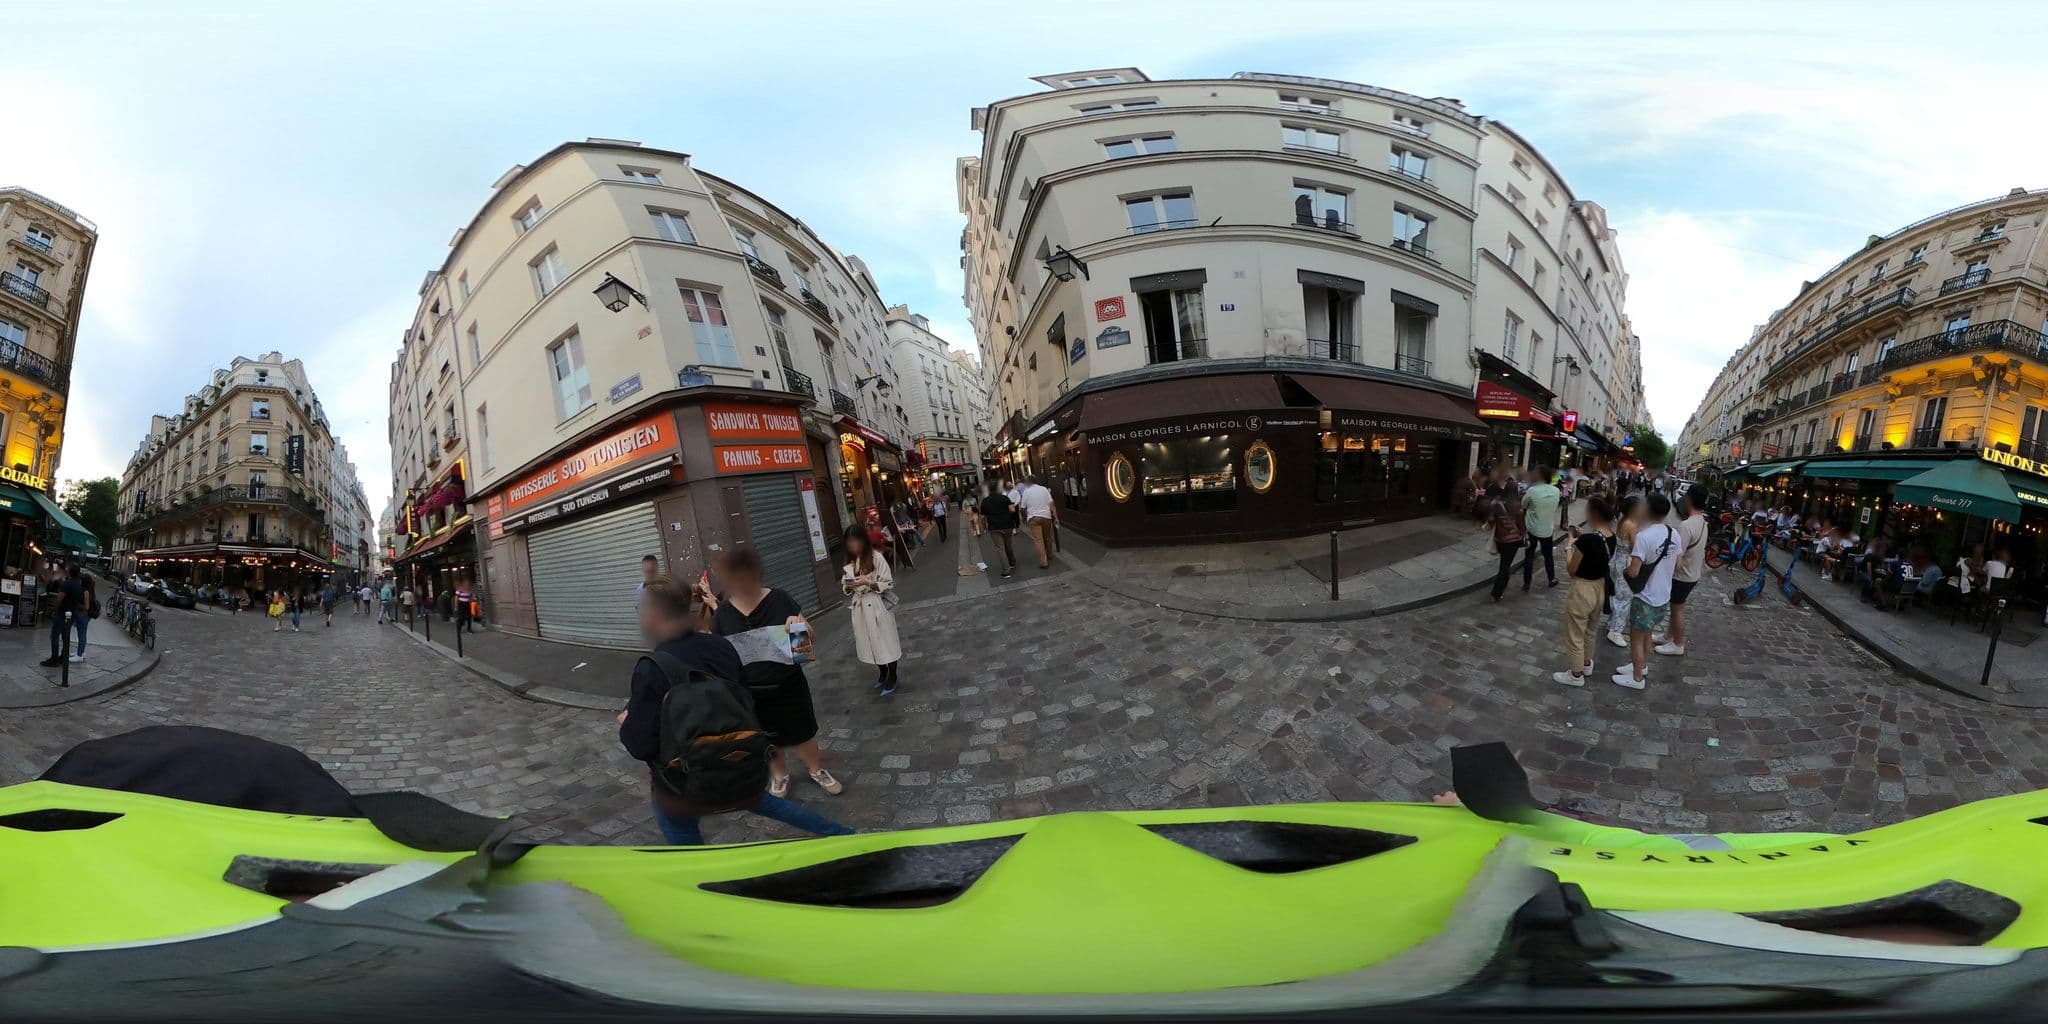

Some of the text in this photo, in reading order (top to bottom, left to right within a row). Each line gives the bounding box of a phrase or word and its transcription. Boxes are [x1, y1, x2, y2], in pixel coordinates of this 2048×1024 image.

[710, 412, 800, 432] SANDWICH TUNISIEN
[1341, 418, 1452, 434] MAISON GEORGES LARNICOL
[1088, 420, 1242, 445] MAISON GEORGES LARNICOL
[510, 424, 660, 503] PATISSERIE SUD TUNISIEN
[723, 449, 761, 467] PANINIS
[773, 449, 803, 464] CREPES
[1983, 447, 2034, 472] UNION
[1, 467, 47, 491] QUARE
[618, 477, 645, 493] SANDWICH
[562, 499, 576, 513] SUD
[576, 488, 609, 509] TUNISIEN
[1958, 499, 1973, 508] 7/7
[2017, 491, 2036, 502] UNION
[1901, 564, 1914, 579] 30
